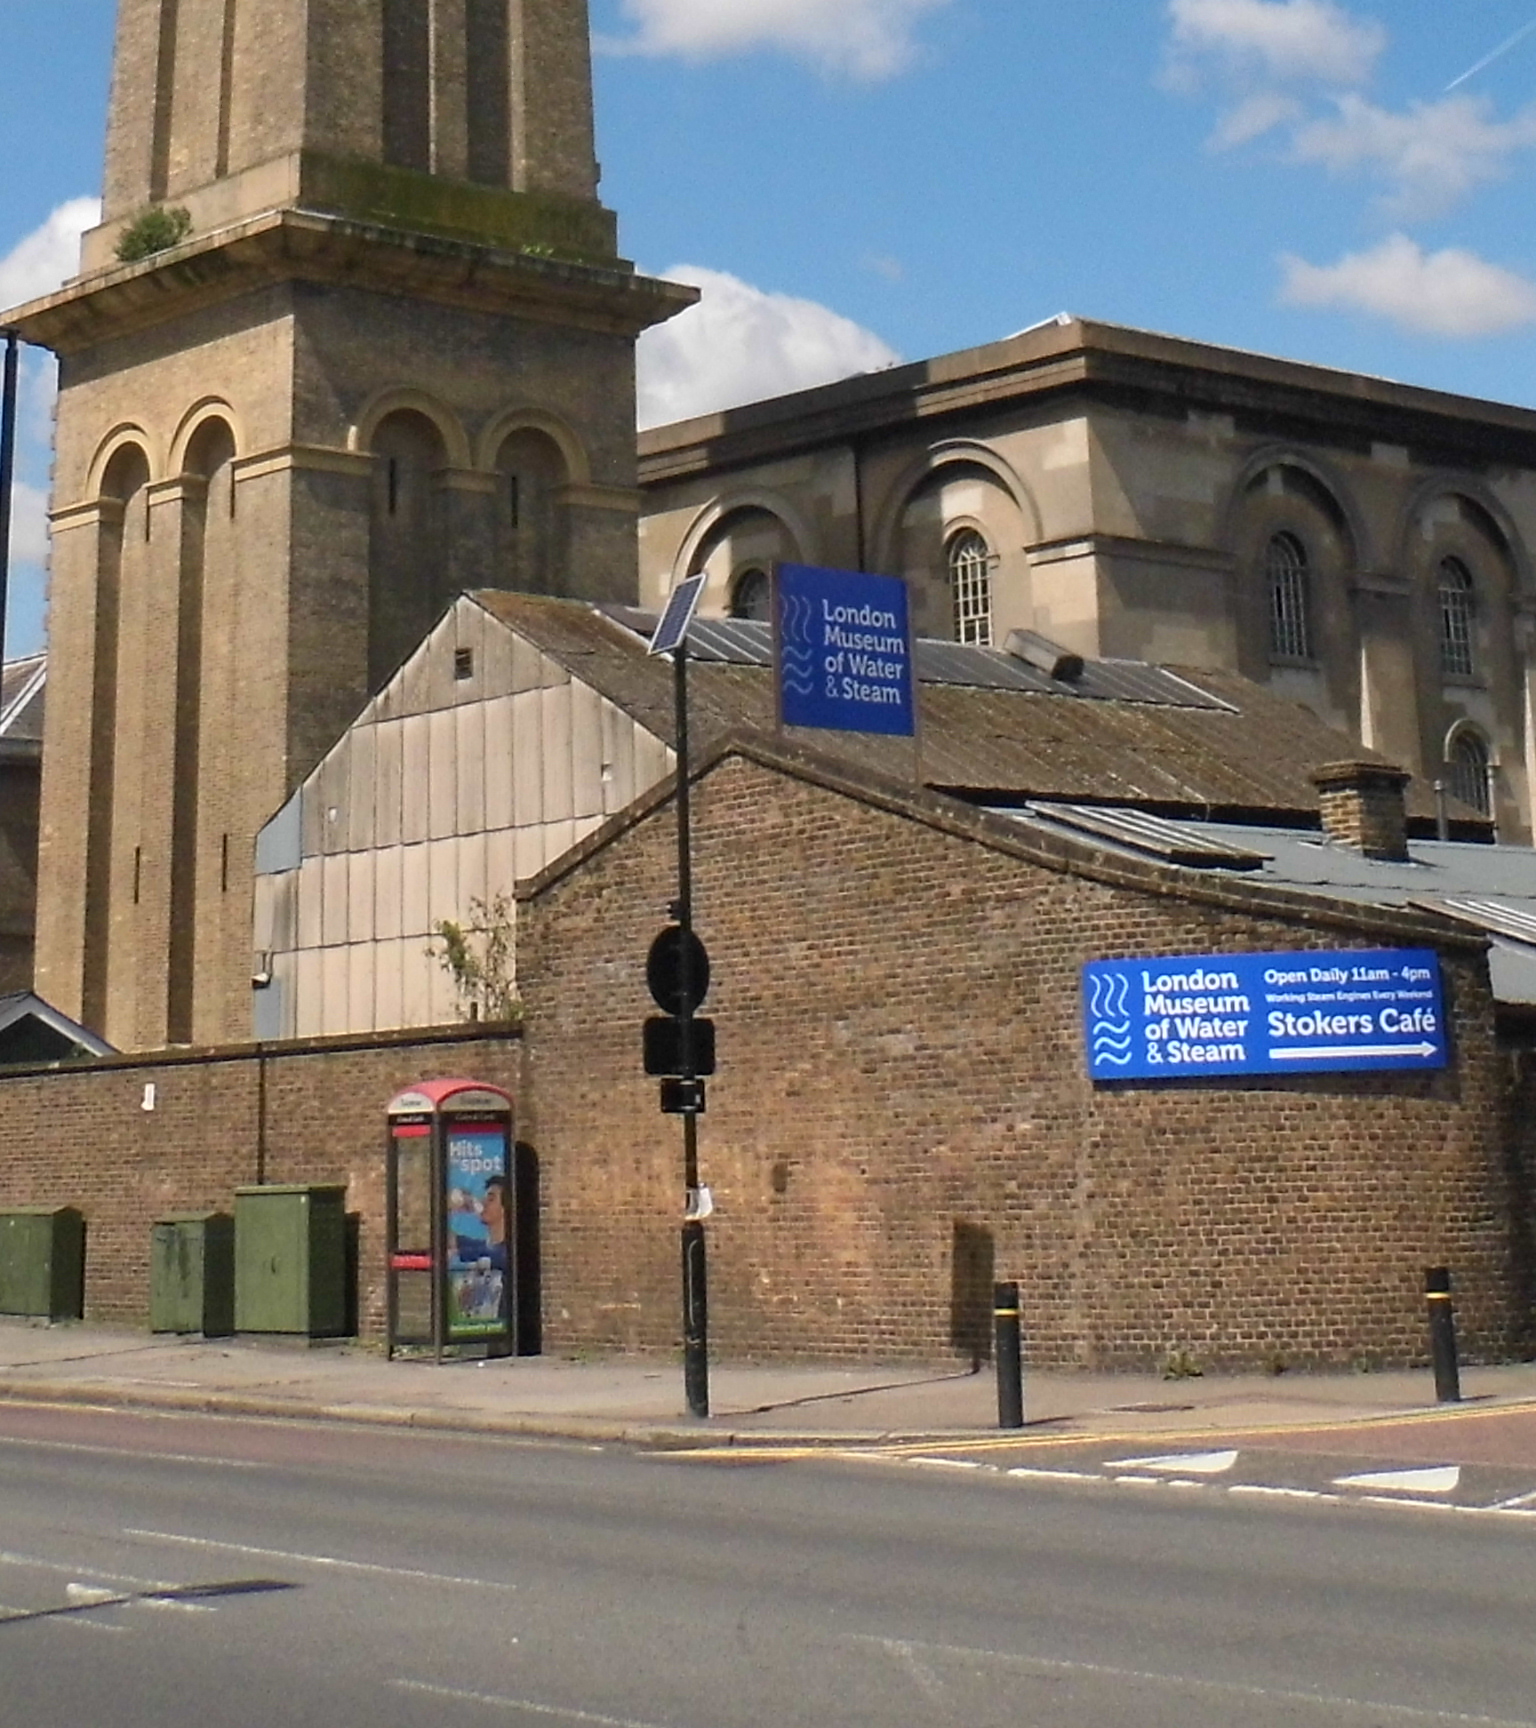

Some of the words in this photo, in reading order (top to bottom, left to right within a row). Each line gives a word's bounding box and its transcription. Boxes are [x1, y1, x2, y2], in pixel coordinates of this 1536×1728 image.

[823, 599, 896, 629] London
[823, 624, 905, 654] Museum
[825, 652, 846, 675] of
[849, 652, 904, 680] Water
[826, 675, 840, 698] &
[842, 676, 901, 704] Steam
[1141, 969, 1239, 992] London
[1264, 969, 1308, 987] Open
[1310, 967, 1348, 984] Daily
[1351, 967, 1390, 981] 11am
[1401, 966, 1431, 982] 4pm
[1144, 992, 1250, 1016] Museum
[1265, 992, 1306, 1004] Working
[1307, 991, 1335, 1002] Steam
[1145, 1017, 1170, 1040] of
[1175, 1016, 1249, 1039] Water
[1268, 1009, 1374, 1037] Stokers
[1379, 1007, 1437, 1034] Café
[1146, 1042, 1164, 1064] &
[1166, 1041, 1246, 1064] Steam
[449, 1139, 483, 1157] Hits
[460, 1155, 503, 1176] spot
